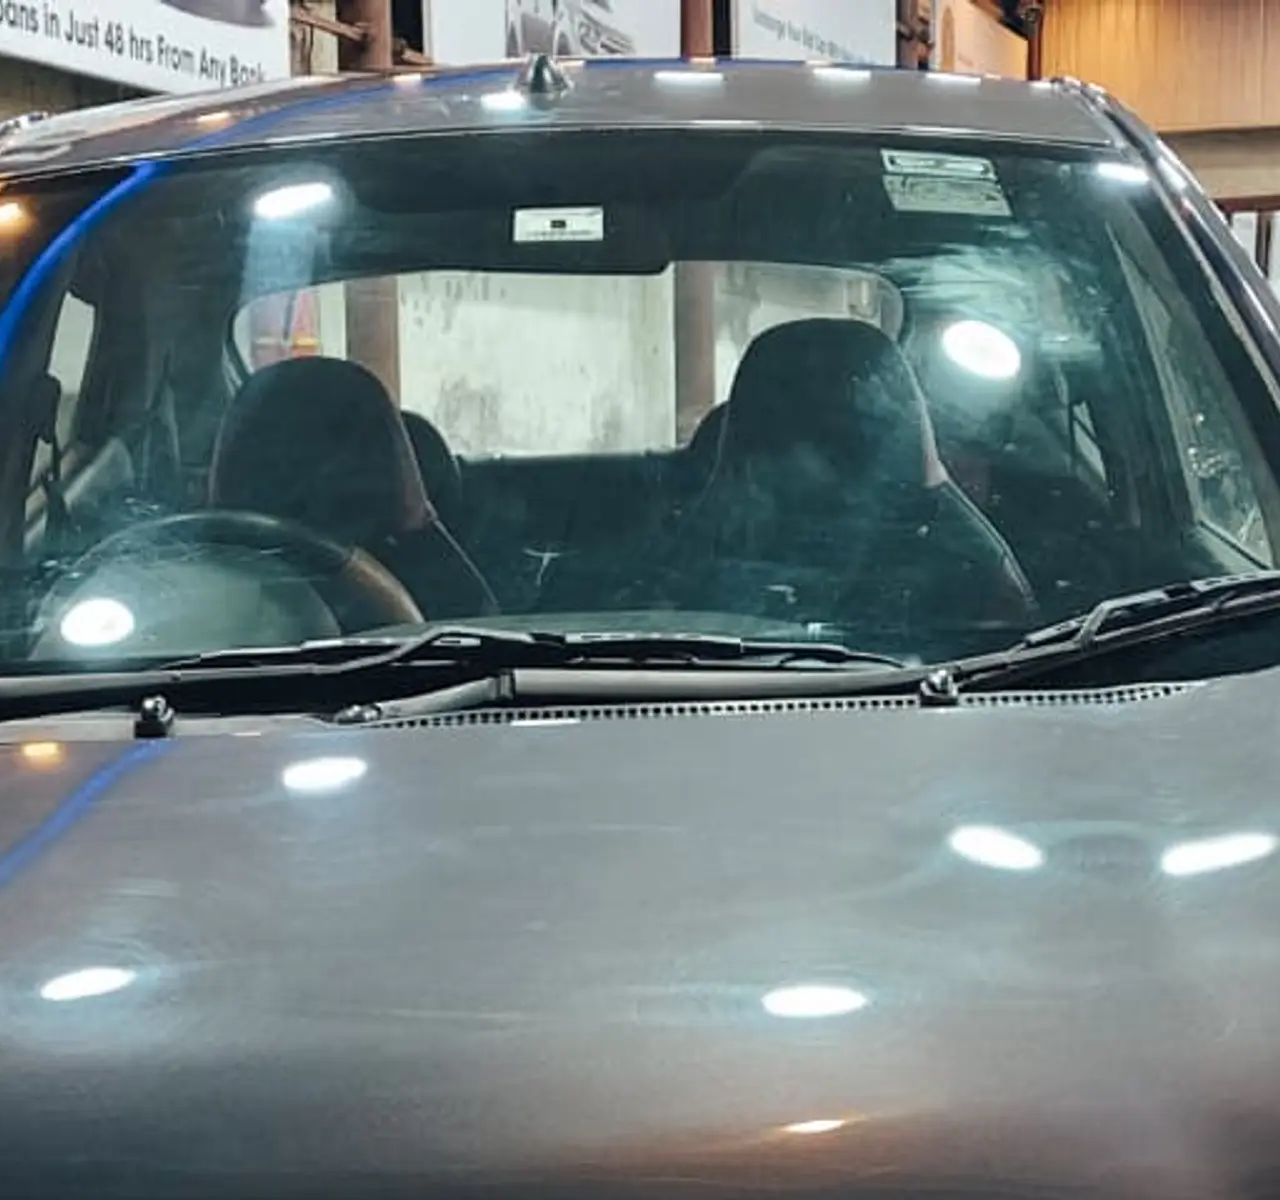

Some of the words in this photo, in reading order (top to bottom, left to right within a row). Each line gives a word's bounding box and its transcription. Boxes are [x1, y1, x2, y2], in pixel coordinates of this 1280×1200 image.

[43, 2, 61, 39] in
[64, 9, 99, 49] Just
[104, 20, 124, 55] 48
[129, 25, 154, 64] hrs
[157, 34, 195, 76] From
[199, 47, 227, 84] Any
